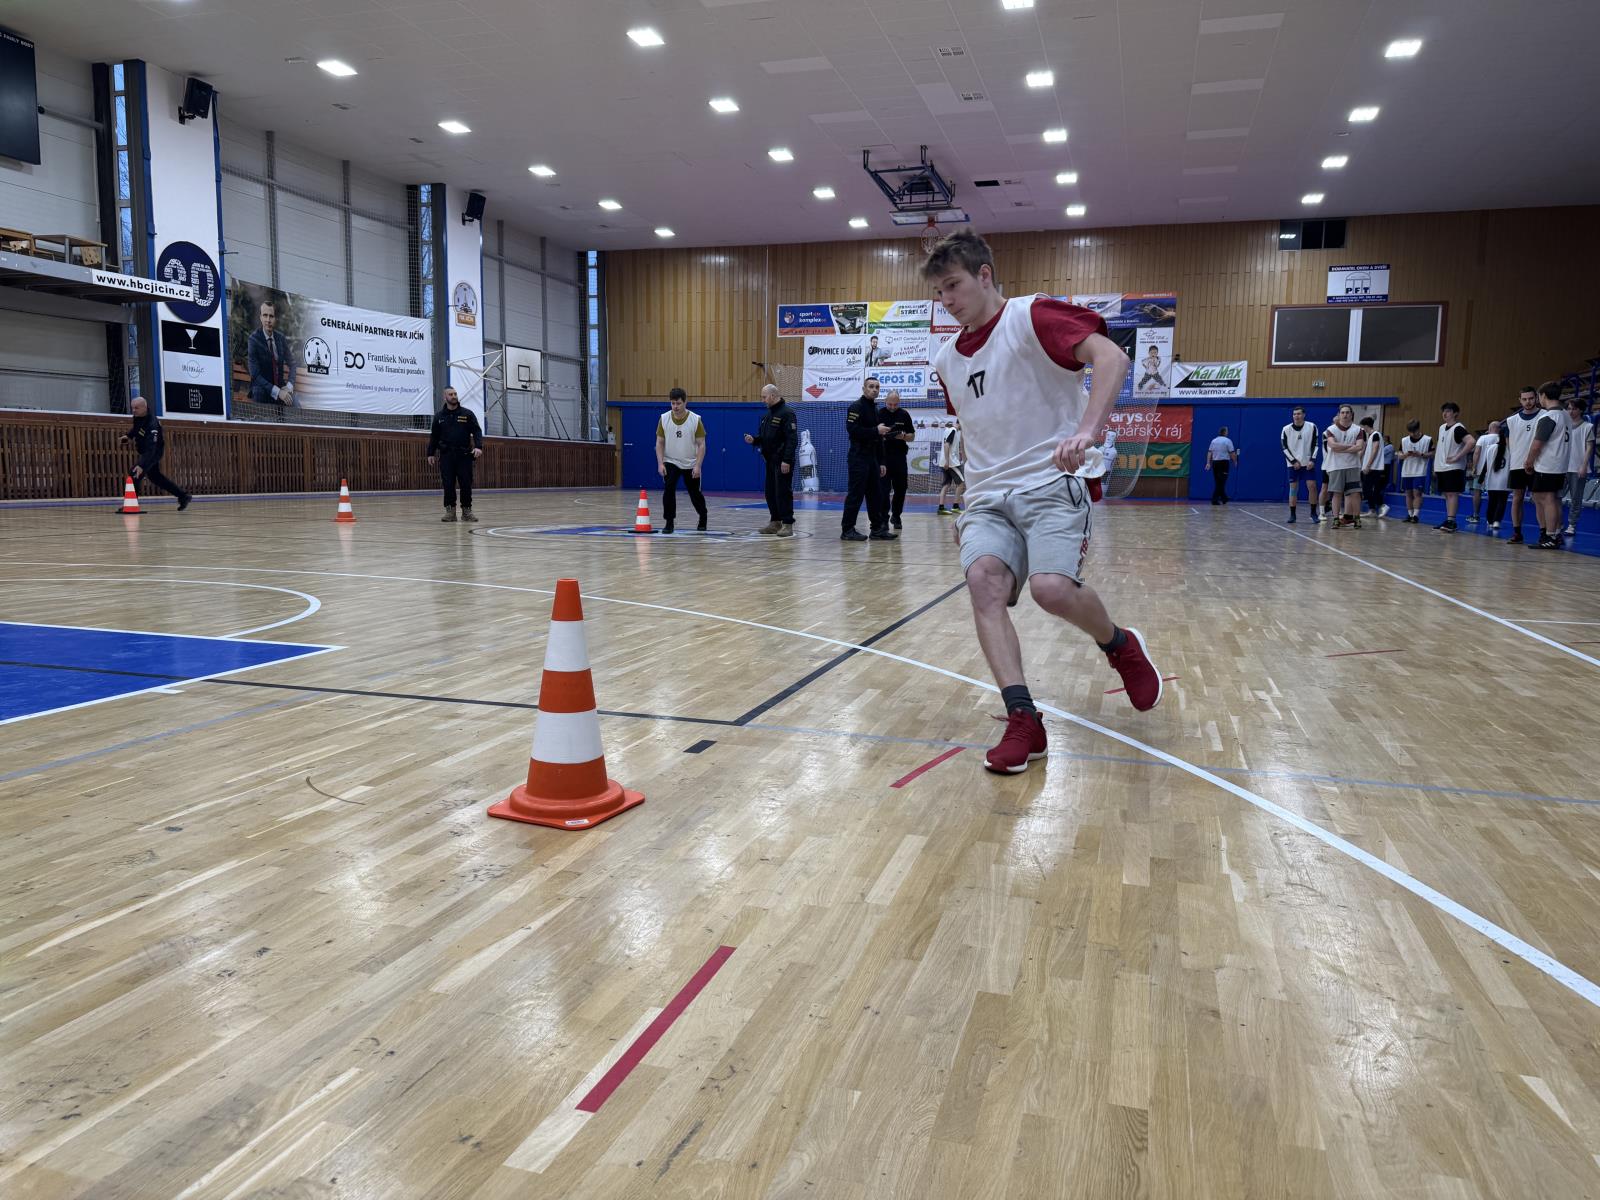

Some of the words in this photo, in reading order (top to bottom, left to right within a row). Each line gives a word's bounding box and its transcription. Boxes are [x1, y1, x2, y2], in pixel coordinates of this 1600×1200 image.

[96, 273, 191, 298] www.hbcjicin.cz
[320, 317, 364, 333] GENERÁLNÍ
[364, 325, 395, 338] PARTNER
[395, 329, 408, 339] FBK
[408, 330, 424, 341] JIČÍN
[817, 347, 840, 355] PIVNICE
[367, 352, 397, 364] František
[398, 356, 418, 365] Novák
[1190, 365, 1216, 379] Kar
[1216, 365, 1243, 379] Max
[967, 370, 985, 399] 17
[1179, 388, 1236, 396] www.karmax.cz
[1109, 411, 1162, 424] arys.cz
[1165, 424, 1183, 439] ráj
[1526, 424, 1531, 432] 5
[1116, 454, 1183, 470] ance
